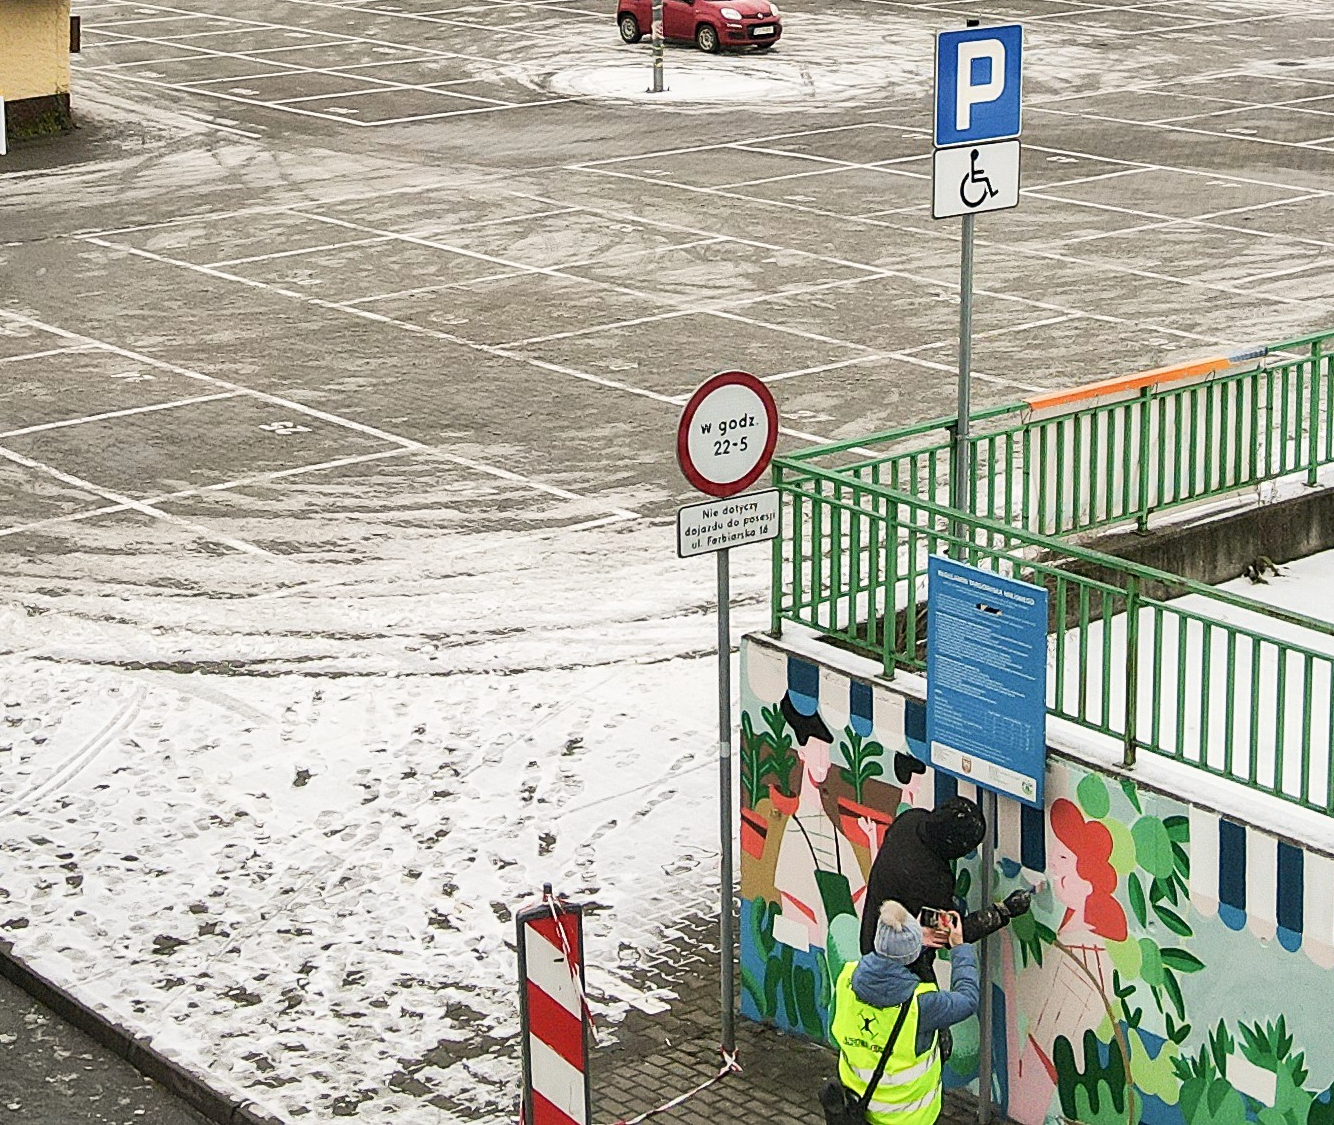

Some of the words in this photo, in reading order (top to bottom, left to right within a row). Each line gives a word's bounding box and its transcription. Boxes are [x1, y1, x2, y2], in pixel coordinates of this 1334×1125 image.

[956, 38, 1006, 131] P
[700, 422, 712, 434] w
[718, 412, 759, 436] godz.
[713, 436, 748, 456] 22-5
[702, 508, 719, 519] Nie
[722, 502, 758, 515] dotyczy
[685, 521, 723, 537] dojazdu
[727, 519, 740, 528] do
[743, 509, 776, 527] posesji
